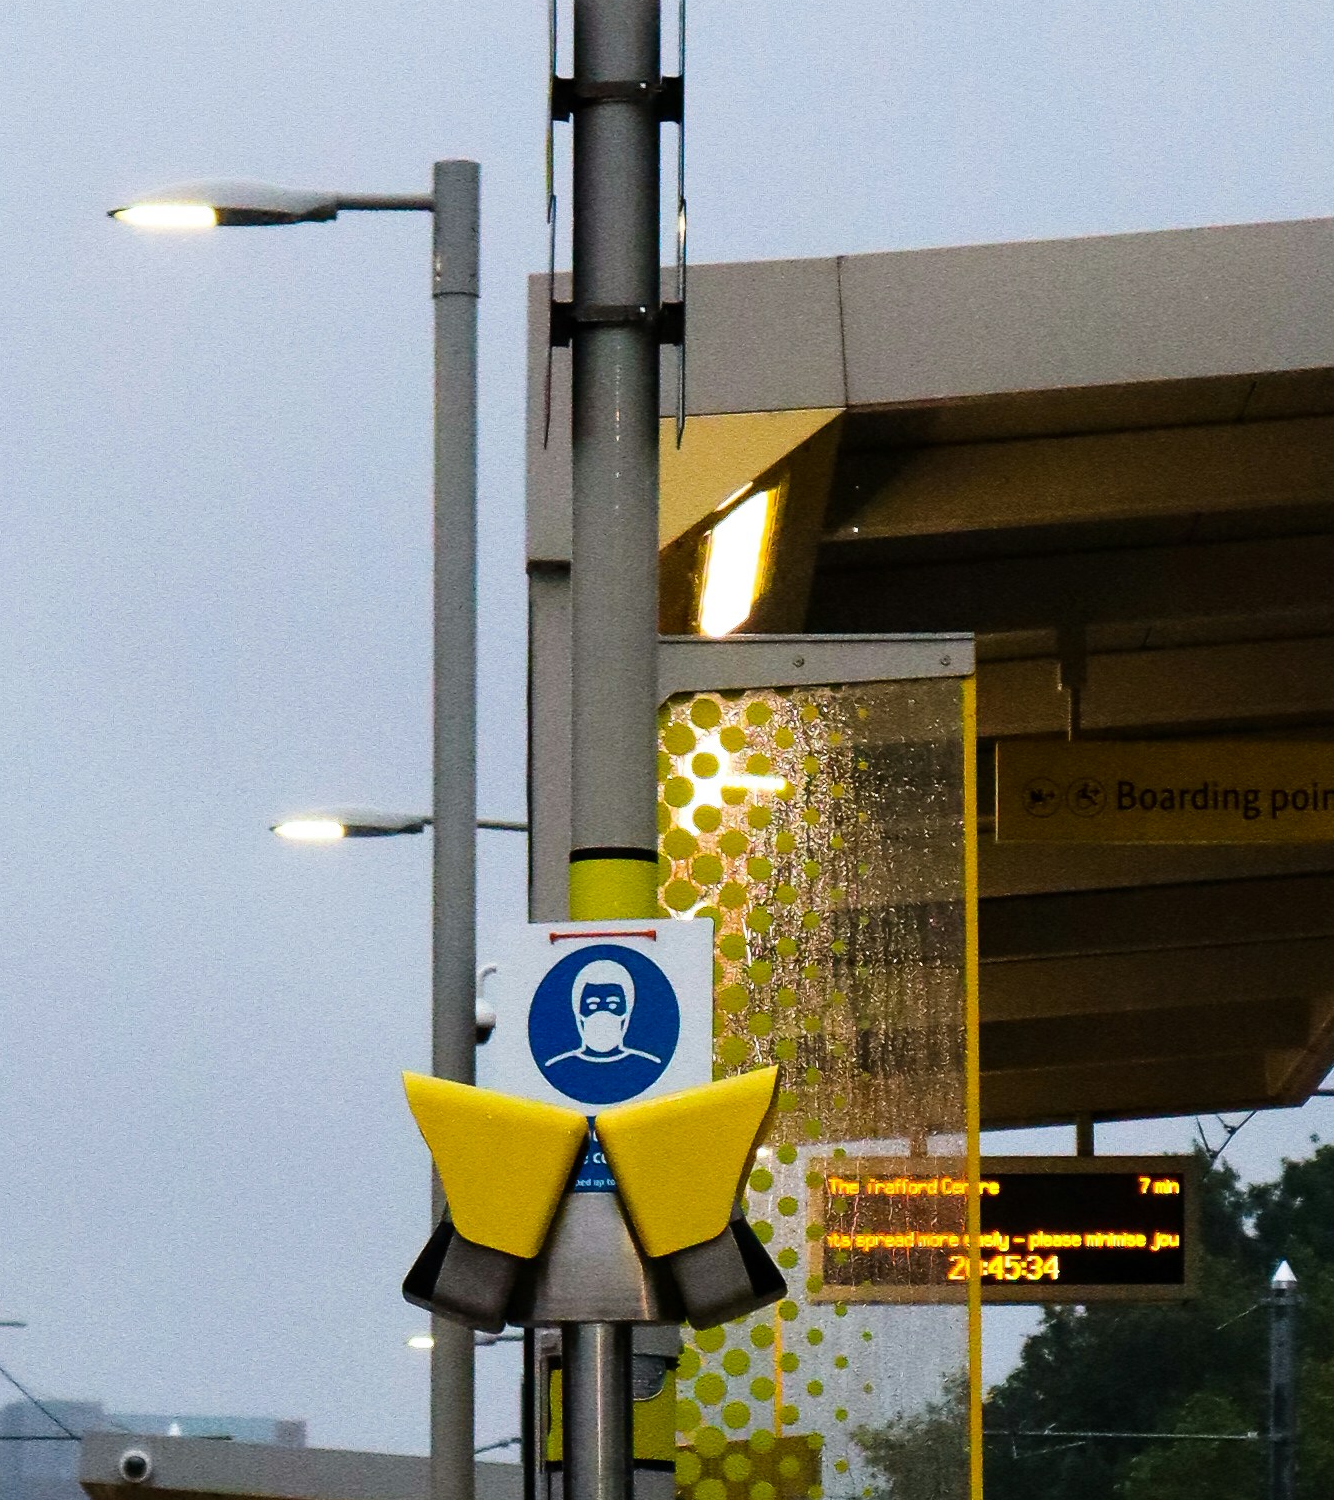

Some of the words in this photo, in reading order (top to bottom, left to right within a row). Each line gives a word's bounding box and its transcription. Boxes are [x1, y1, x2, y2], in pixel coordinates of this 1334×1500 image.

[1117, 781, 1262, 820] Boarding
[828, 1177, 860, 1196] The
[1138, 1176, 1151, 1195] 7
[1153, 1178, 1180, 1195] min
[854, 1231, 914, 1252] spread
[917, 1234, 960, 1248] more
[1028, 1230, 1082, 1252] please
[1084, 1231, 1147, 1248] minimise
